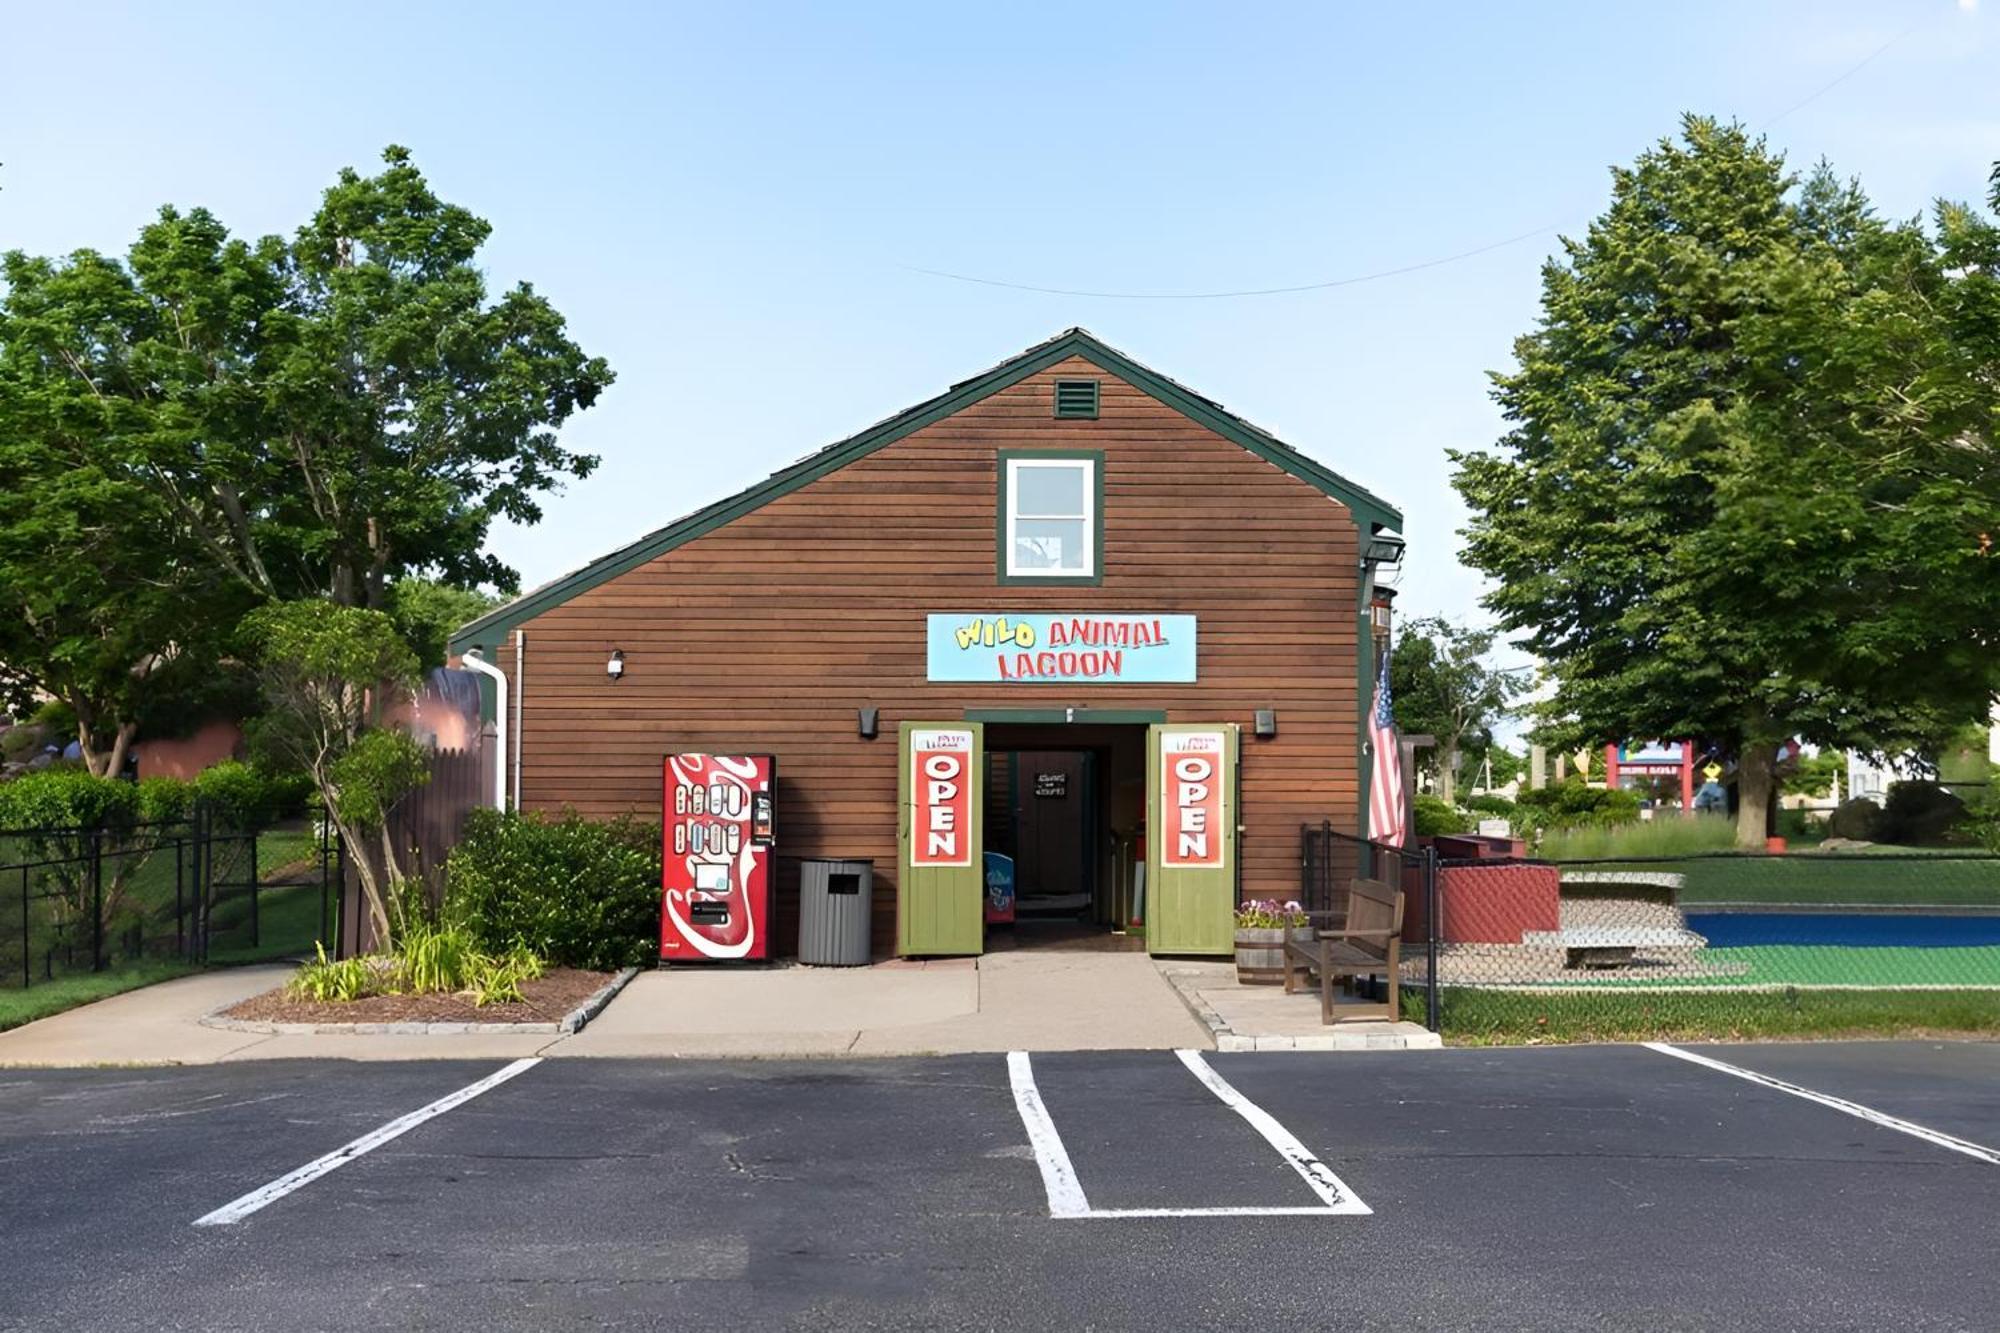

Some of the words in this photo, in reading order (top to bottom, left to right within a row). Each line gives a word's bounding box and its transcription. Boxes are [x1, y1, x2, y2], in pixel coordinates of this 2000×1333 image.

[954, 617, 1036, 650] WILD
[1049, 618, 1169, 649] ANIMAL
[998, 650, 1123, 680] LAGOON
[925, 755, 961, 857] OPEN
[1175, 757, 1212, 859] OPEN
